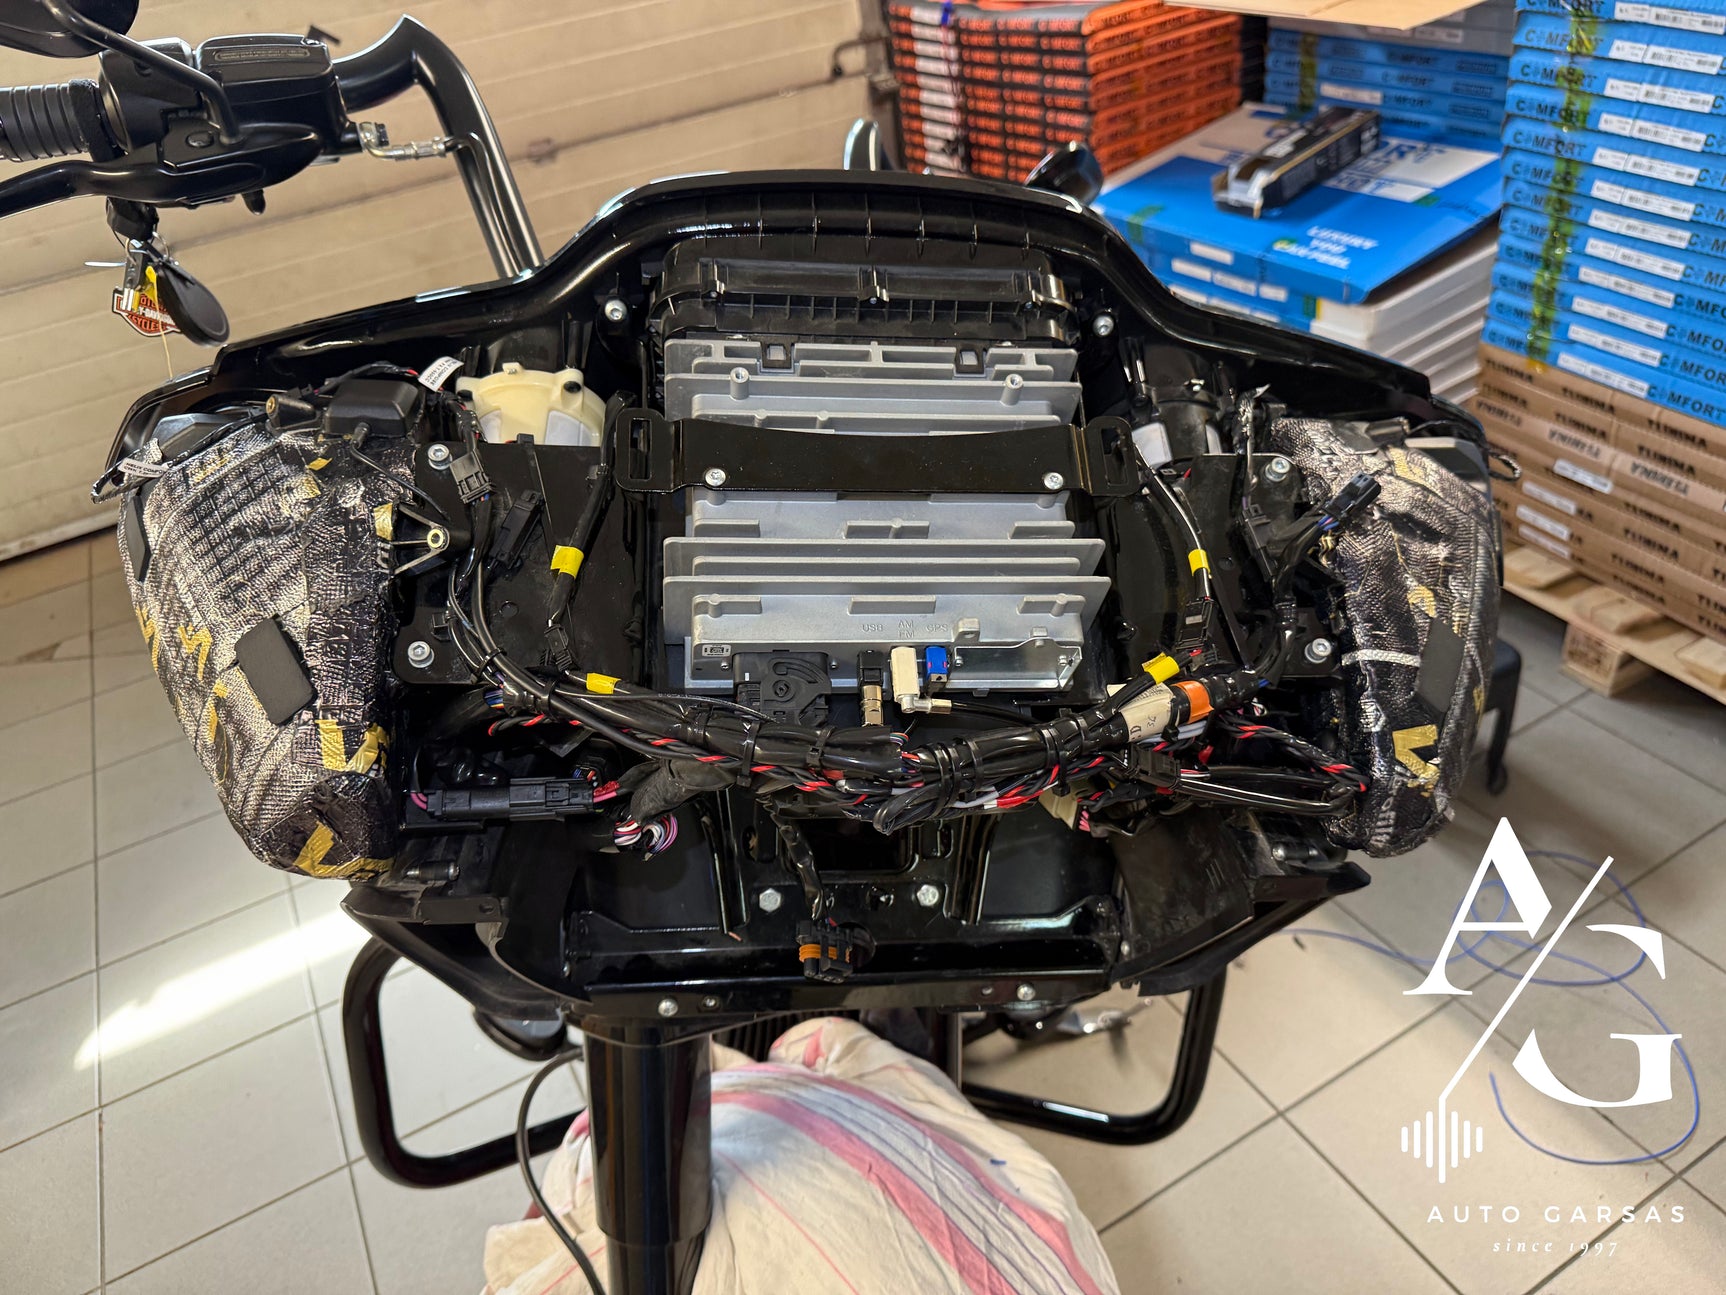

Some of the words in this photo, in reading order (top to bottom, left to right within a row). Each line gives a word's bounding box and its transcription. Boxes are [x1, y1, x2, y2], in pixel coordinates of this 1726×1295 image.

[862, 624, 884, 633] USB
[898, 619, 914, 629] AM
[925, 623, 948, 633] GPS
